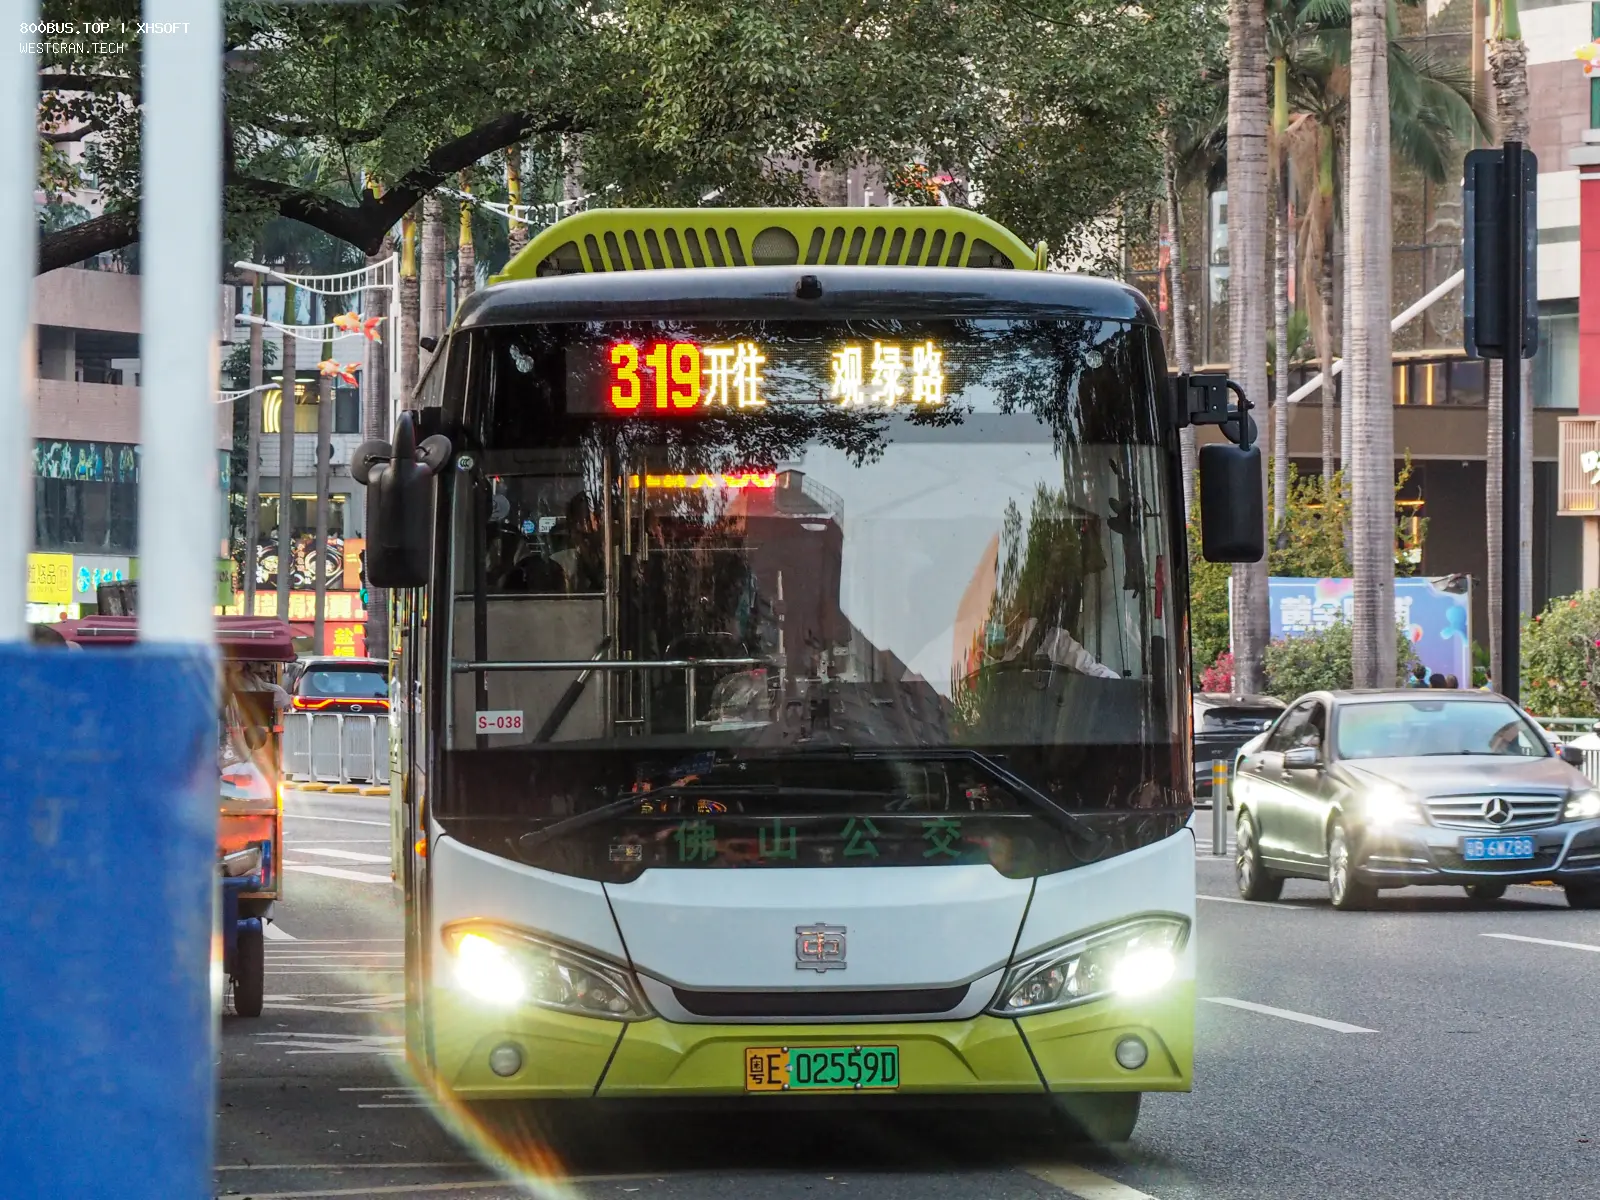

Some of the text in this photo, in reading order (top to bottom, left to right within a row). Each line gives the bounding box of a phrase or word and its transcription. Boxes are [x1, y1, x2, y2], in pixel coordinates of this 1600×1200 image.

[609, 341, 945, 409] 319 开往 观绿路
[478, 715, 521, 729] S-038
[674, 817, 962, 862] 佛山公交
[796, 1052, 896, 1083] 02559D
